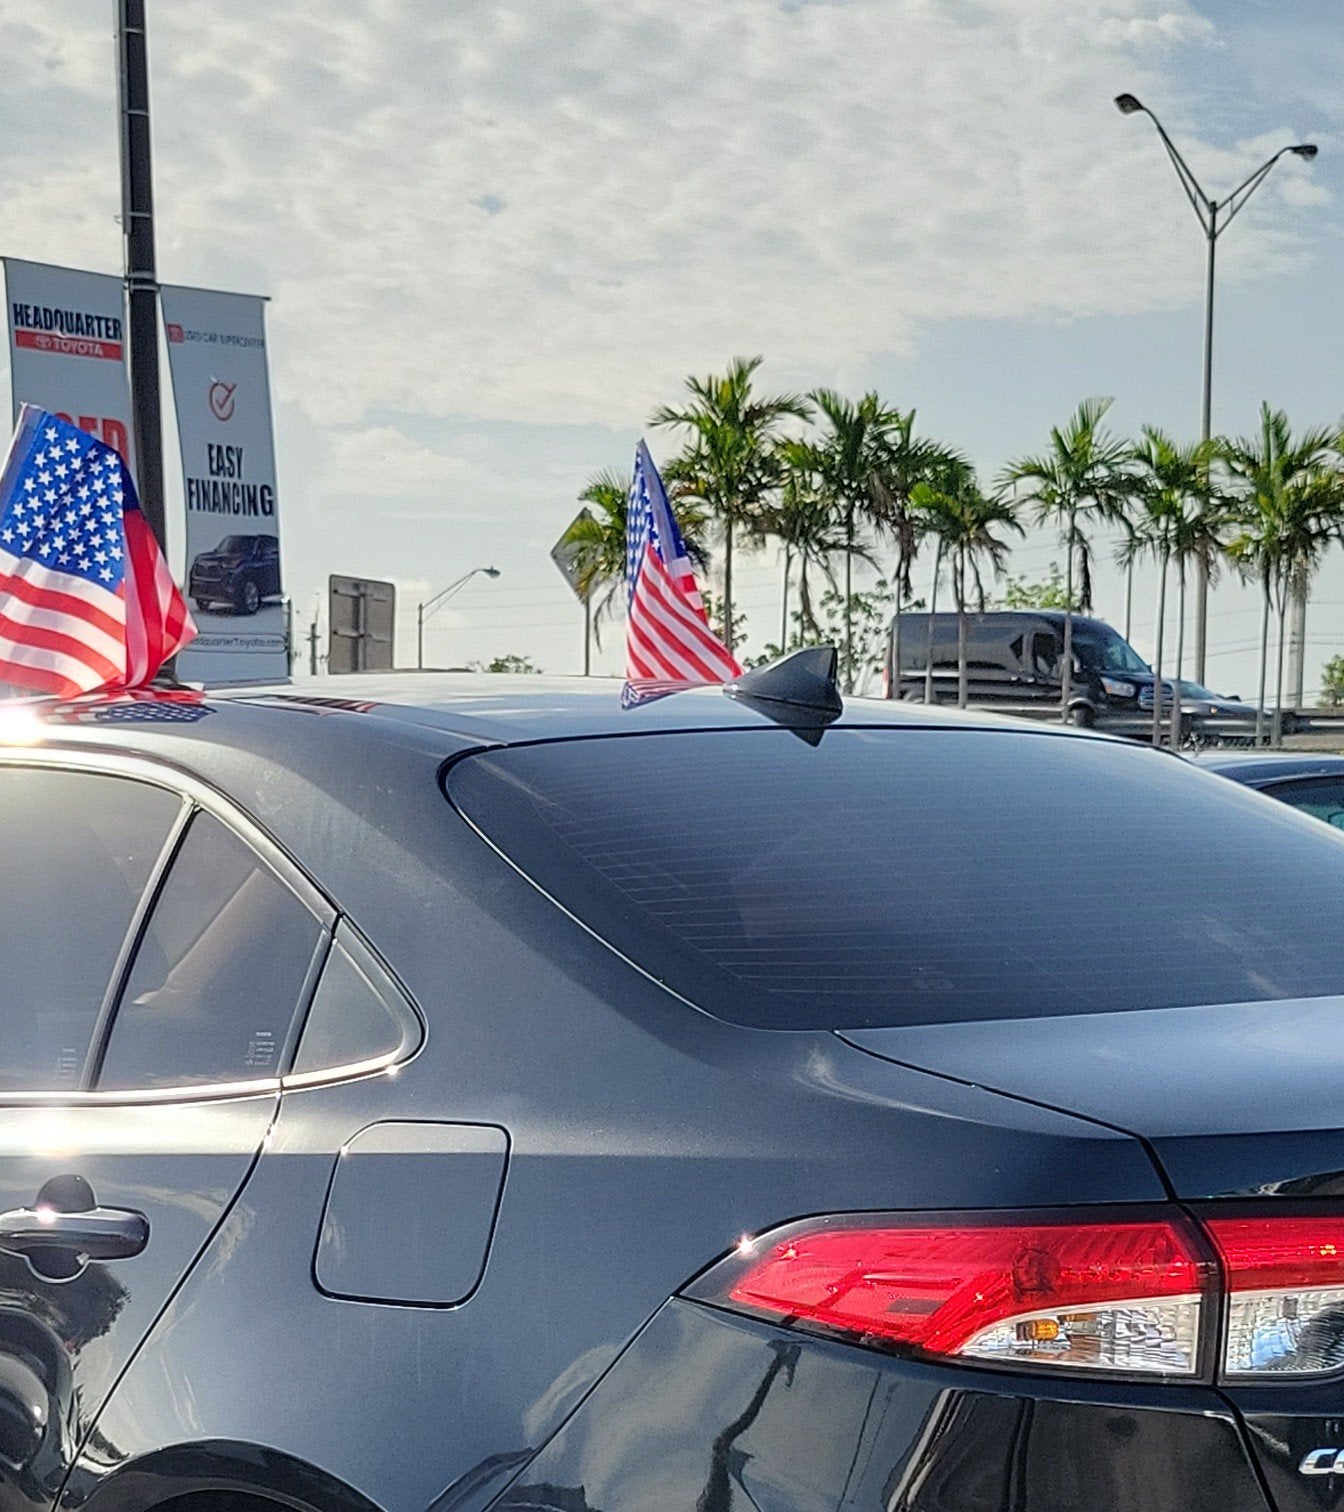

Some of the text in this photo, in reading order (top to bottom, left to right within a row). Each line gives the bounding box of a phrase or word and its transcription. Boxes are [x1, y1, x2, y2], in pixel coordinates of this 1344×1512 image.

[13, 303, 123, 339] HEADQUARTER
[53, 337, 104, 356] TOYOTA
[207, 443, 243, 479] EASY
[187, 478, 274, 517] FINANCING
